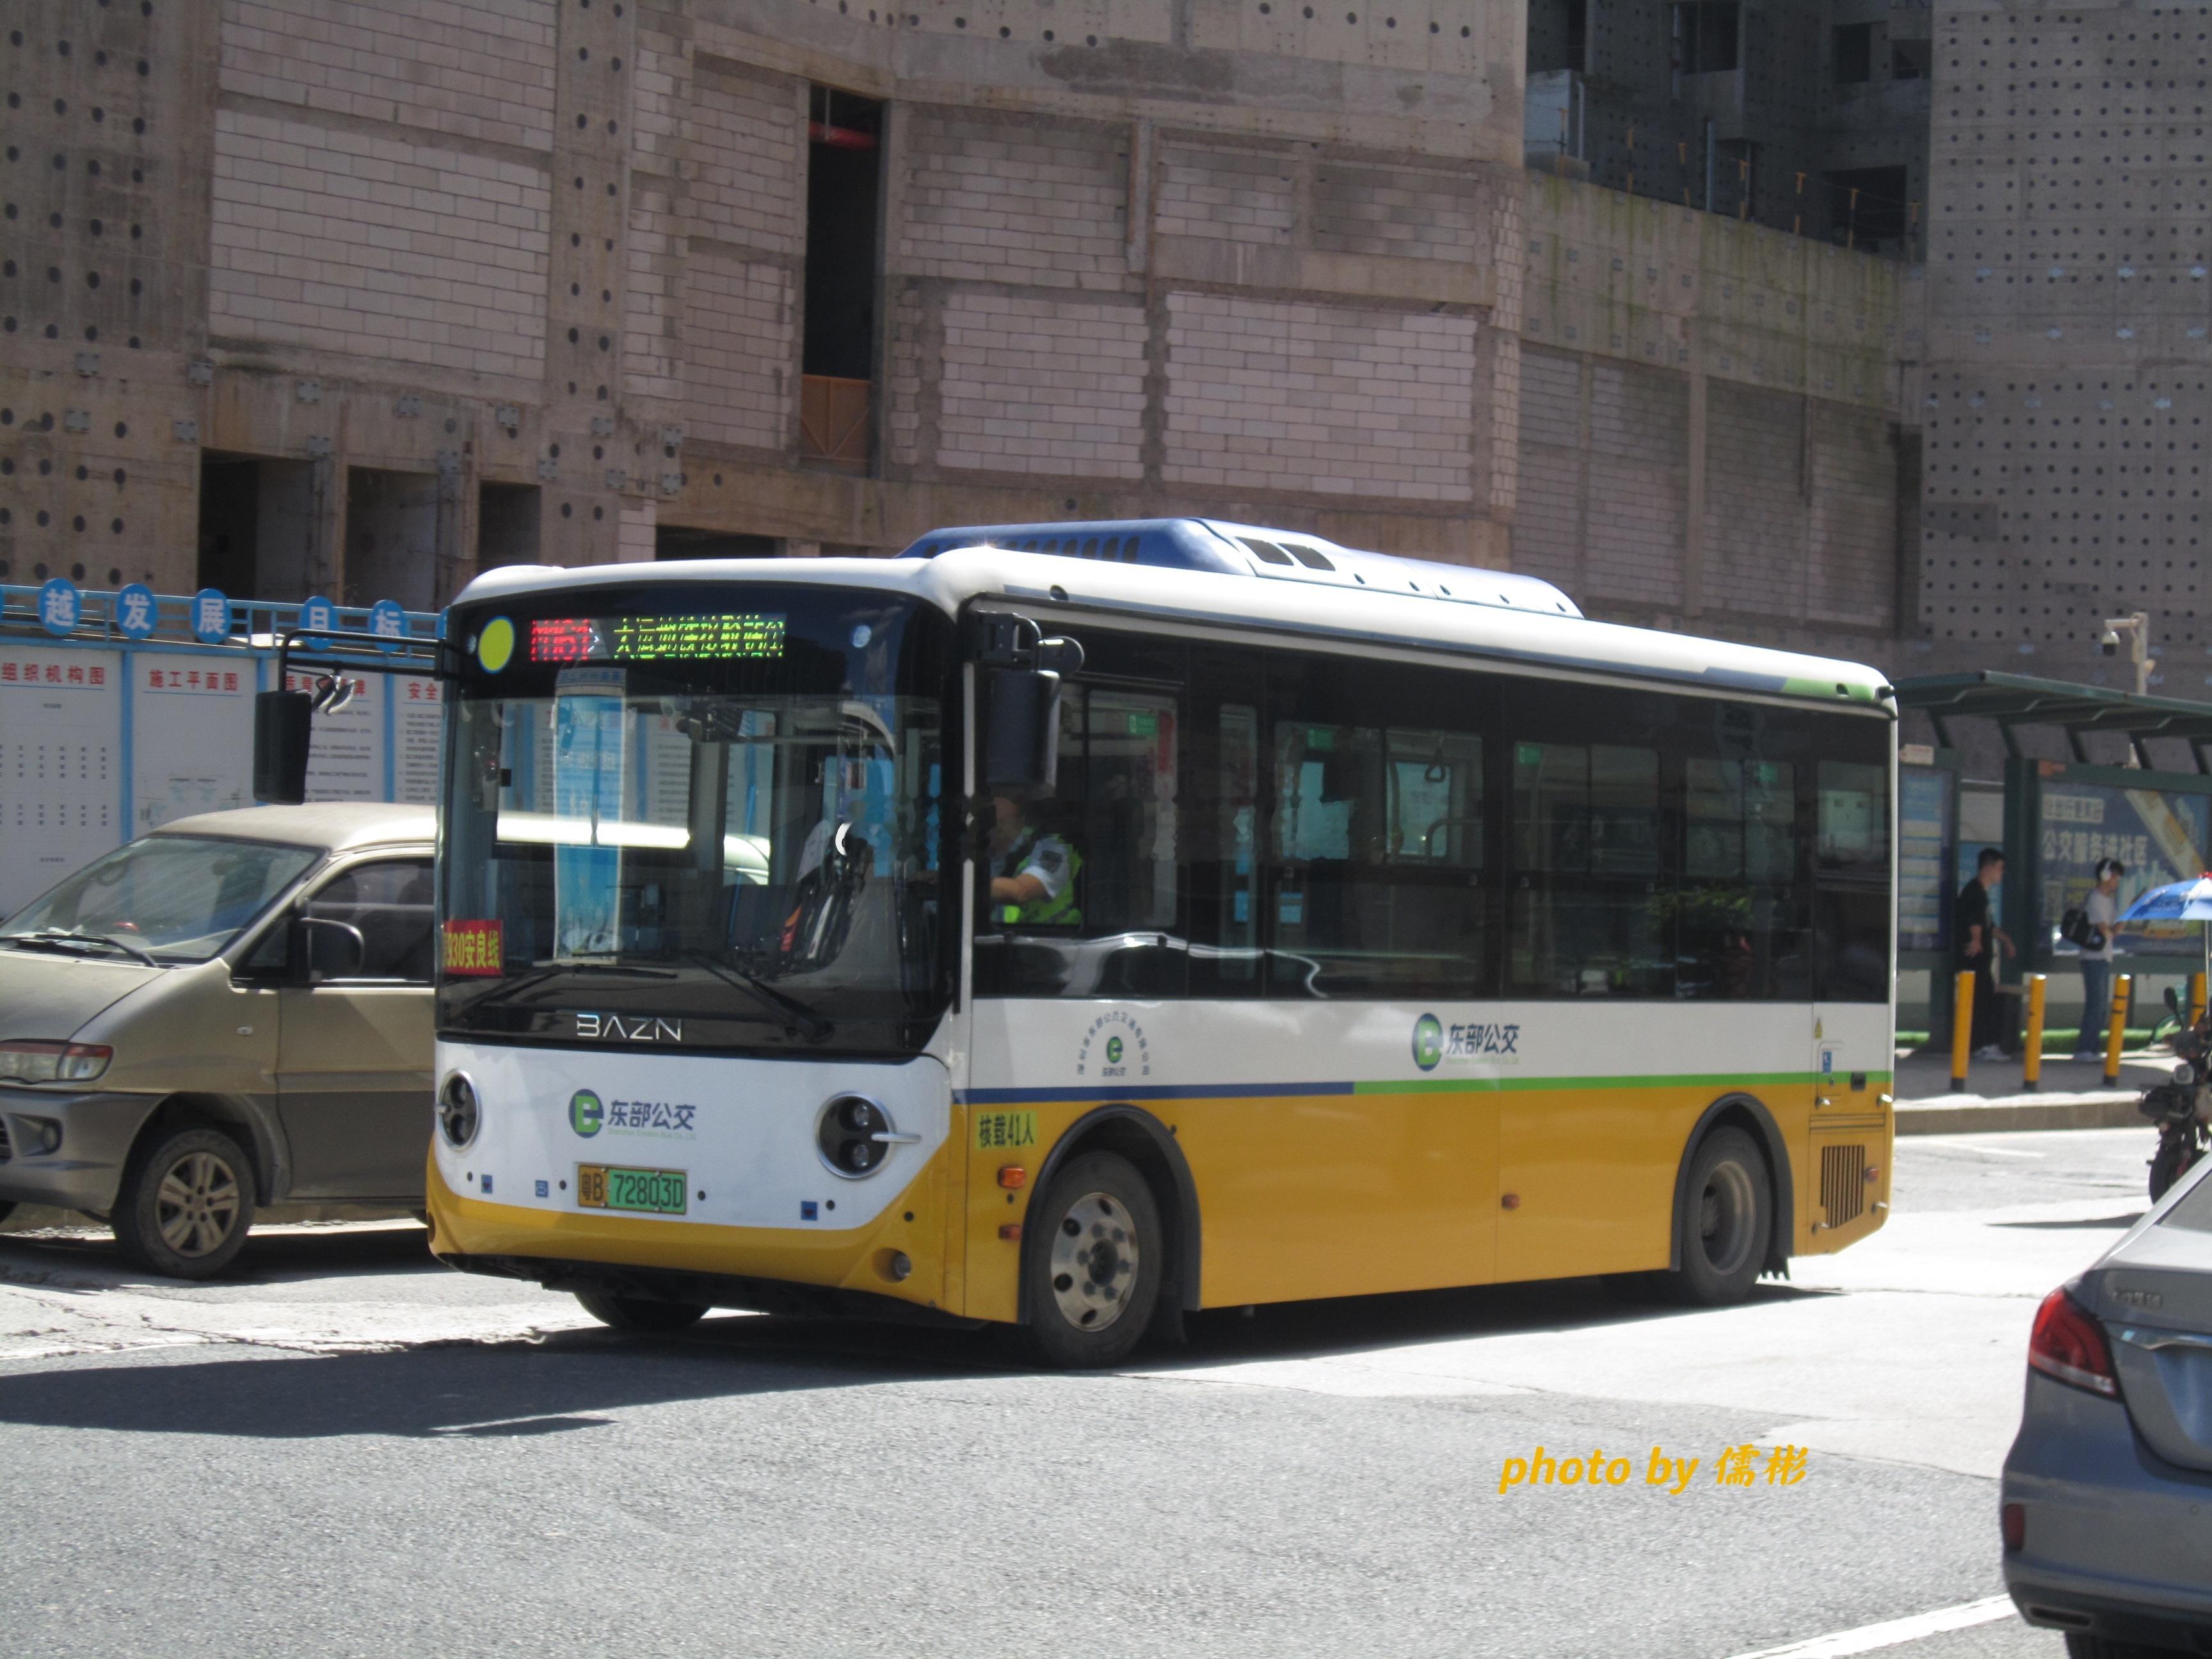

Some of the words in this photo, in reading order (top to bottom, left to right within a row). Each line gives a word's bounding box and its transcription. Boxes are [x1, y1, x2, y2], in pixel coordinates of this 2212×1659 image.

[149, 669, 239, 691] 施工平面图
[577, 1014, 682, 1041] BAZN
[1447, 1023, 1521, 1054] 东部公交
[607, 1099, 696, 1131] 东部公交
[979, 1112, 1034, 1148] 核载41人
